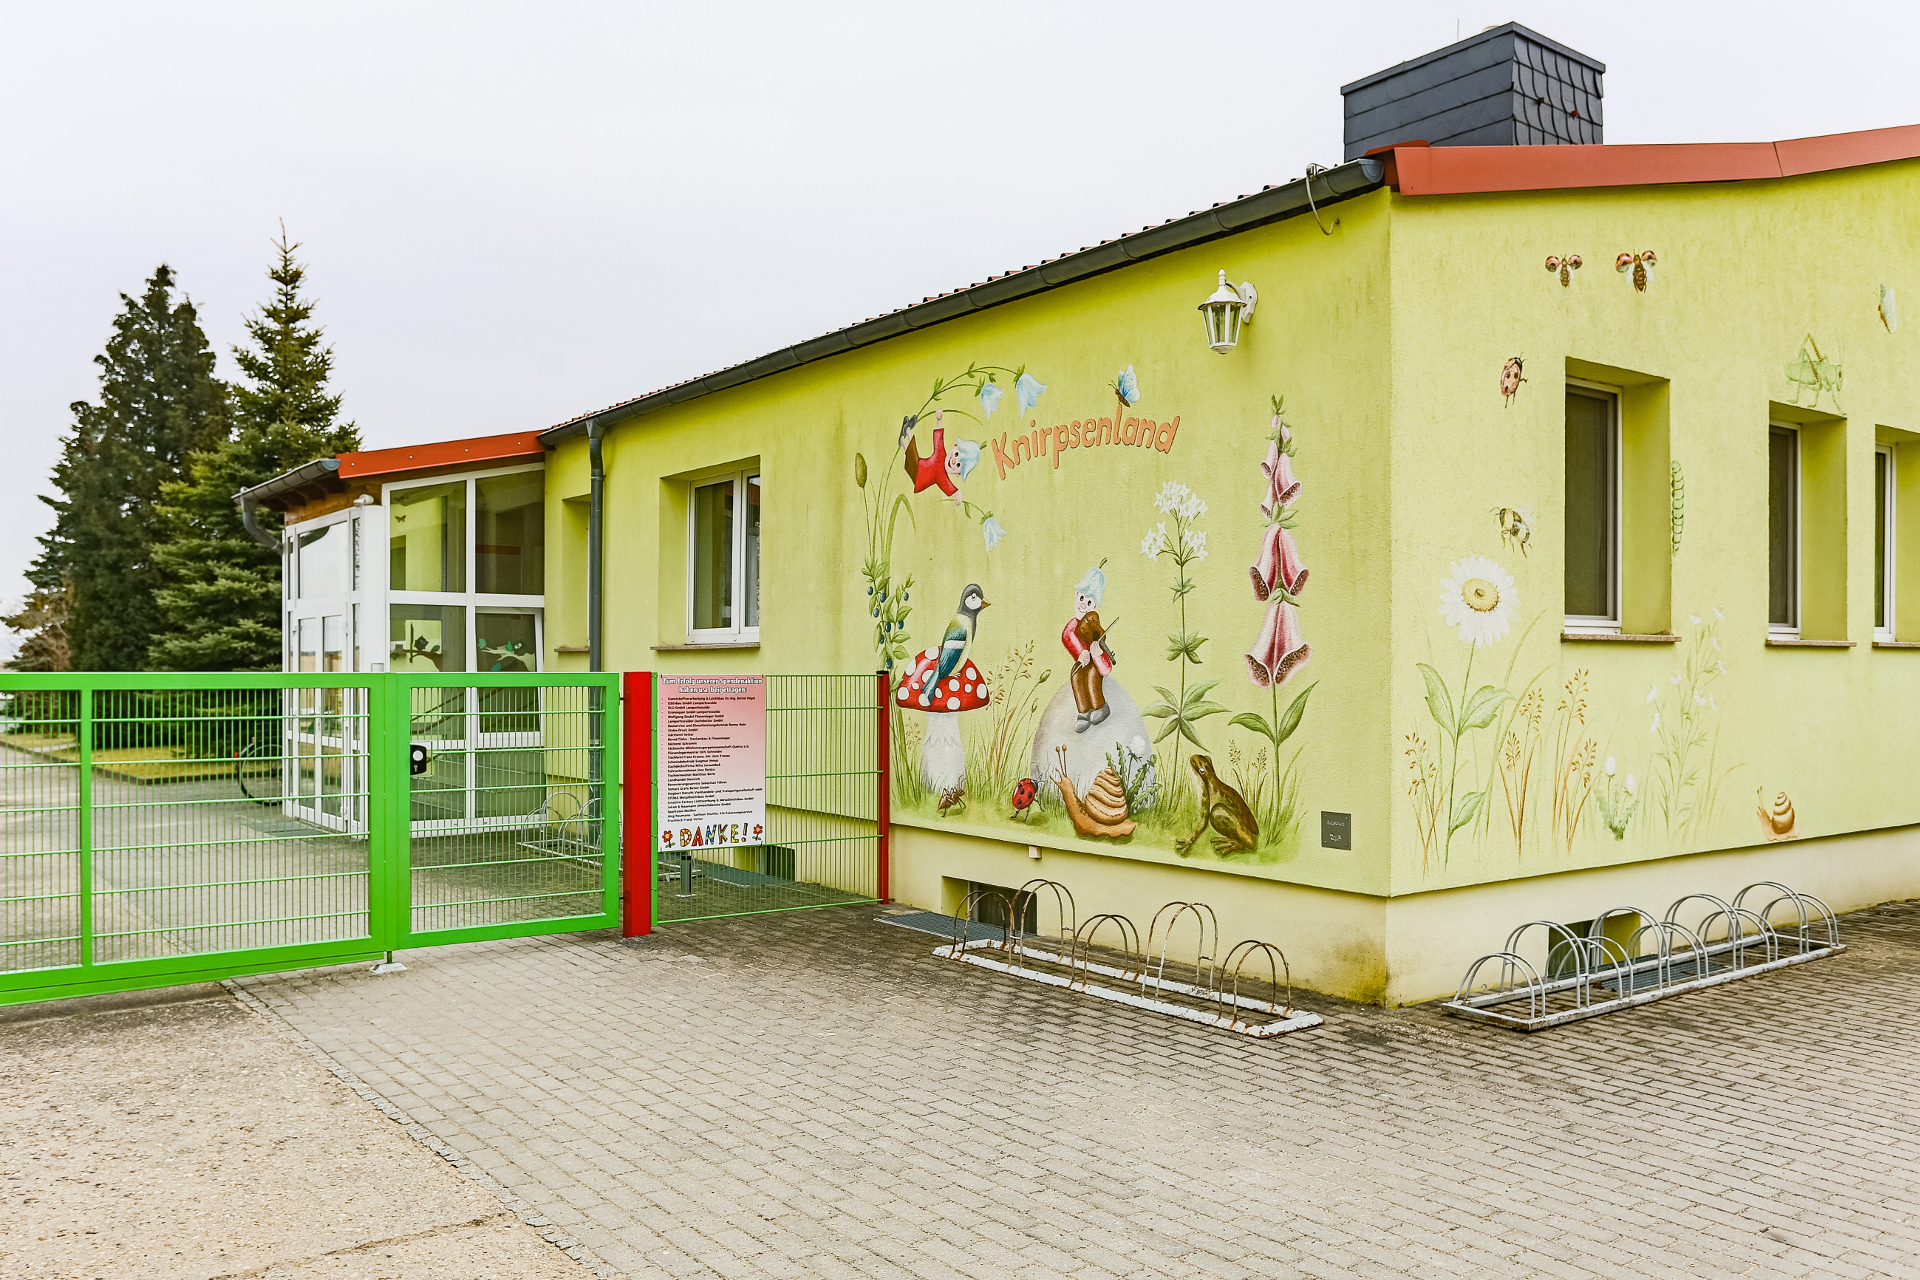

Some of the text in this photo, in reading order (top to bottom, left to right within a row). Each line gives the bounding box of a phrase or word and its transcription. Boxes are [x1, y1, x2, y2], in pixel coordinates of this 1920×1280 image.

[991, 404, 1180, 481] Knirpsenland
[677, 678, 695, 686] Erfolg
[720, 678, 762, 686] Spendenaktion
[680, 823, 748, 847] DANKE!
